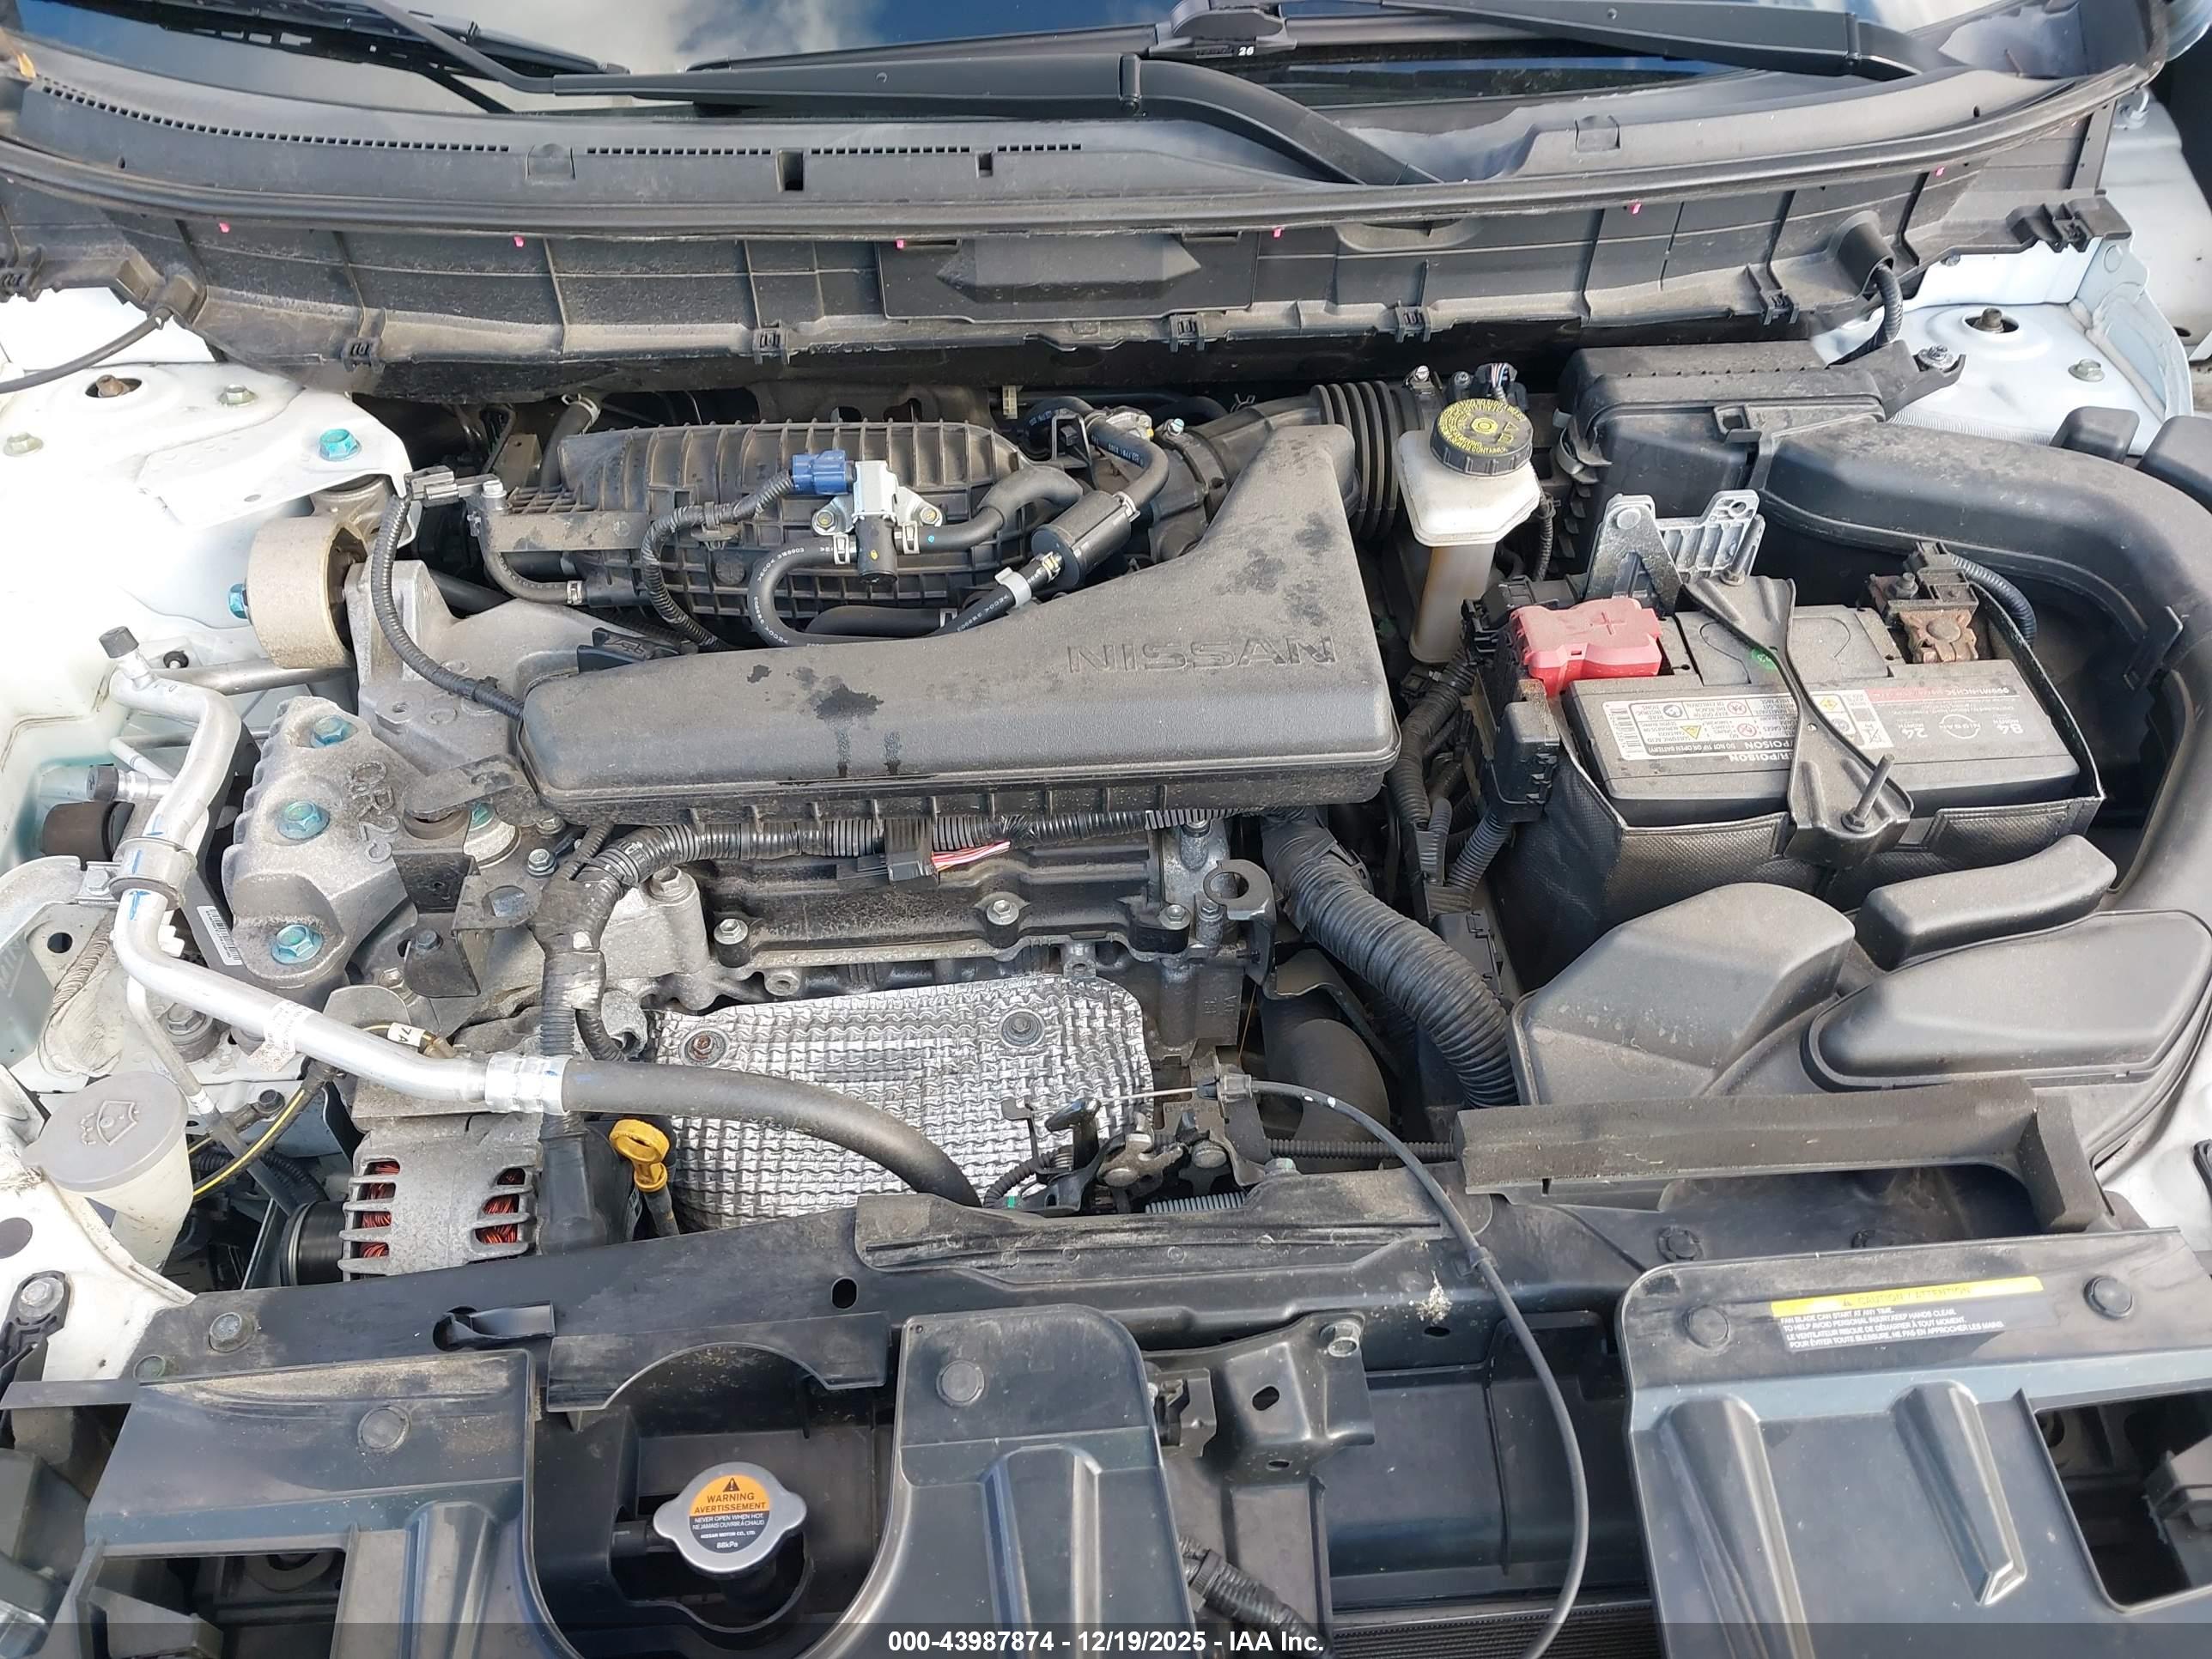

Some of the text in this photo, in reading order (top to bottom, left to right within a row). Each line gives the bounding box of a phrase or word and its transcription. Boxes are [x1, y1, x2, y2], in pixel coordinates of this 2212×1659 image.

[1066, 635, 1337, 673] NISSAN
[1901, 728, 1928, 739] 24
[1996, 723, 2023, 734] 84
[397, 1026, 412, 1042] 7A
[1794, 1322, 1811, 1331] HELP
[1813, 1320, 1832, 1328] AVOID
[1833, 1317, 1868, 1328] PERSONAL
[1909, 1310, 1932, 1320] HANDS
[1832, 1311, 1853, 1320] START
[1918, 1319, 1935, 1328] TOUT
[1833, 1335, 1855, 1344] TOUTE
[1928, 1325, 1967, 1334] APPROCHER
[708, 1492, 755, 1503] WARNING
[694, 1502, 766, 1513] AVERTISSEMENT
